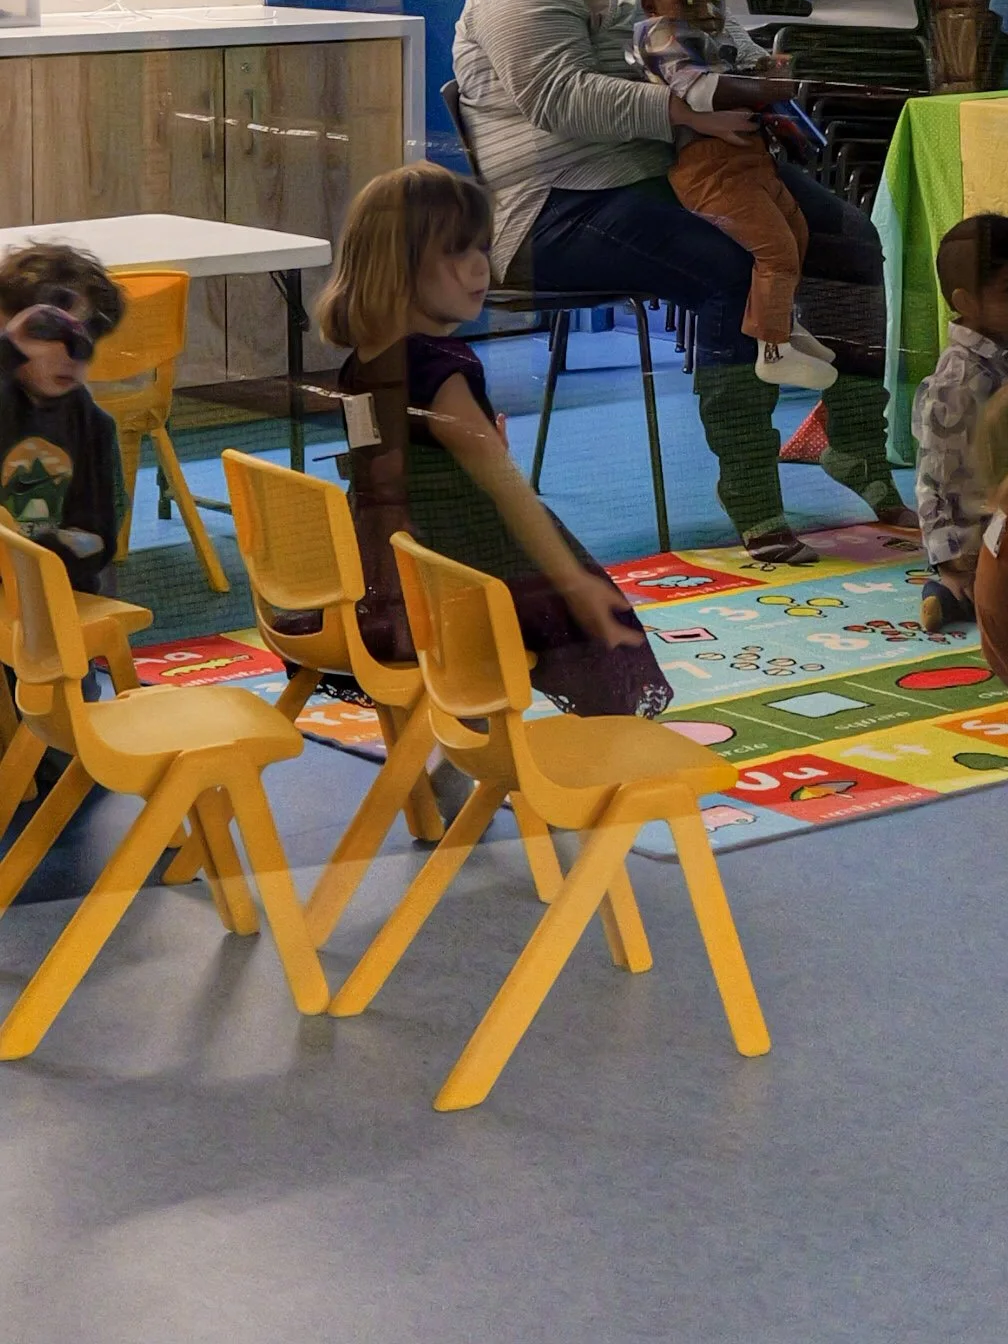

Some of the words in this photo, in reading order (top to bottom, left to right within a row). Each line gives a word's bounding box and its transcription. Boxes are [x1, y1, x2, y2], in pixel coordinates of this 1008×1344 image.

[806, 633, 870, 651] 8
[660, 660, 712, 679] 7
[717, 741, 770, 758] ircle
